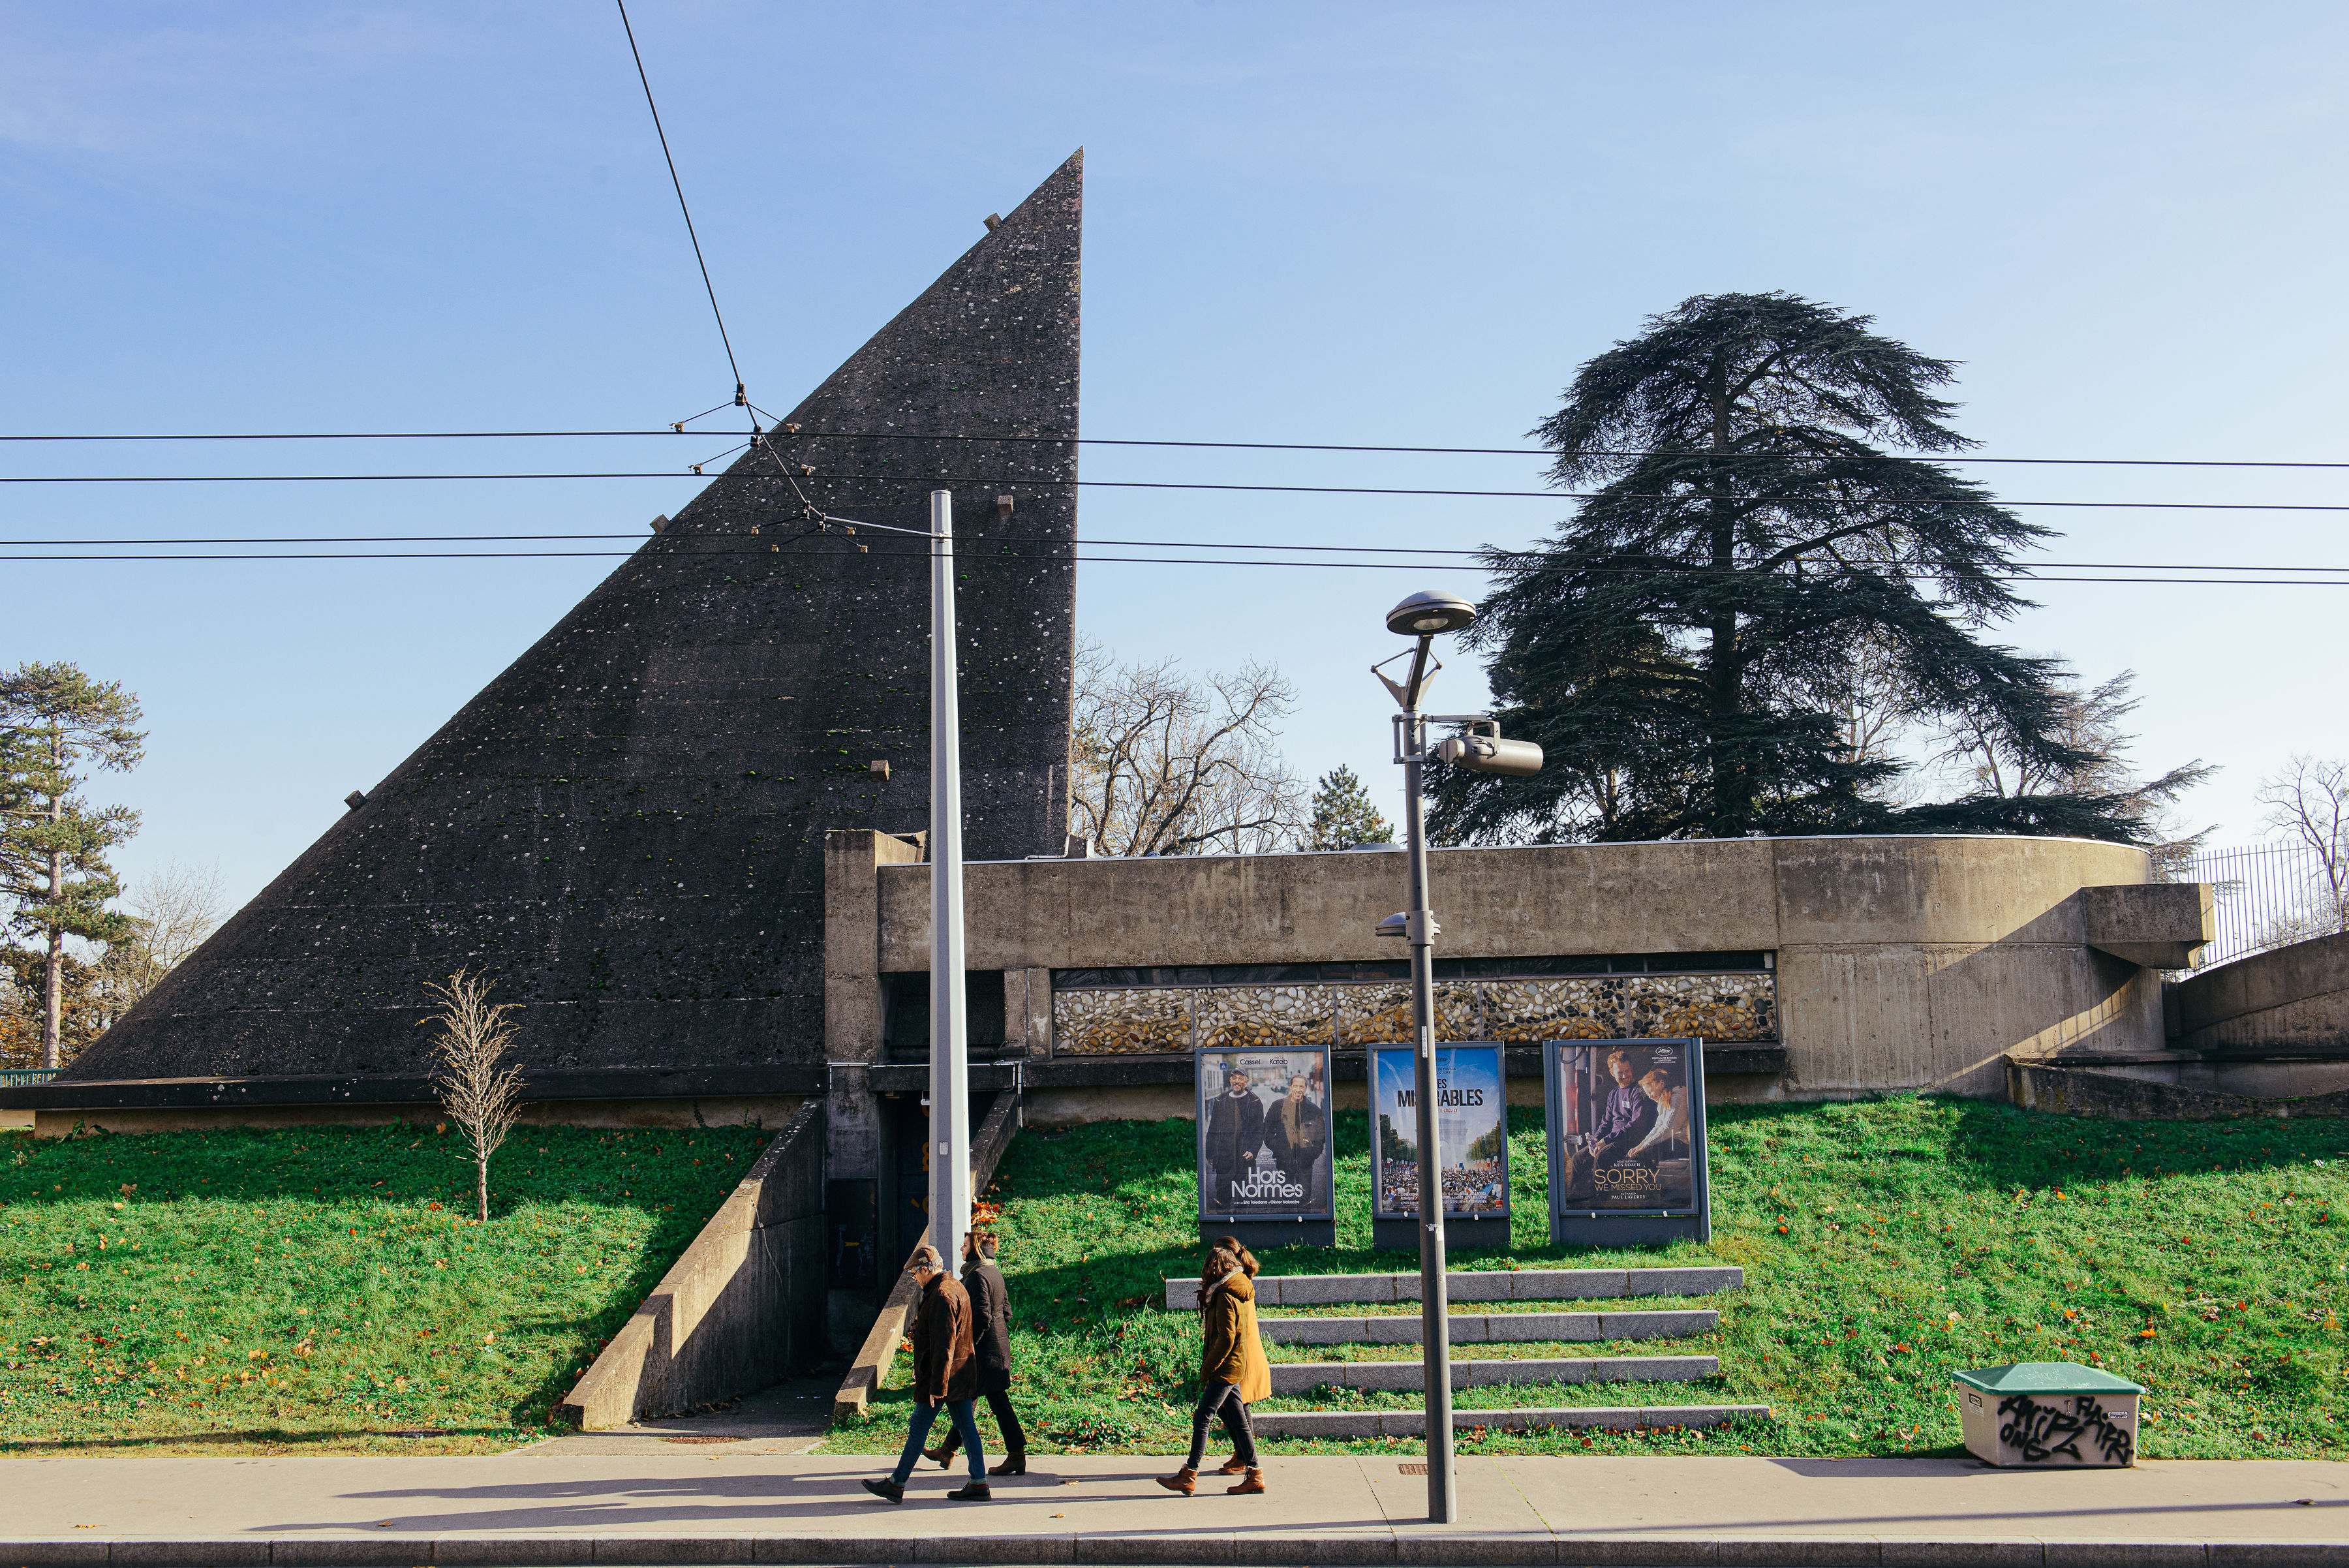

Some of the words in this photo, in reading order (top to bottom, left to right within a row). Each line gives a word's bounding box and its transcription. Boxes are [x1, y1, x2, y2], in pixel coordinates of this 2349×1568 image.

[1437, 1079, 1447, 1089] ES
[1248, 1167, 1286, 1184] Hors
[1594, 1169, 1661, 1184] SORRY
[1231, 1180, 1303, 1198] Normes
